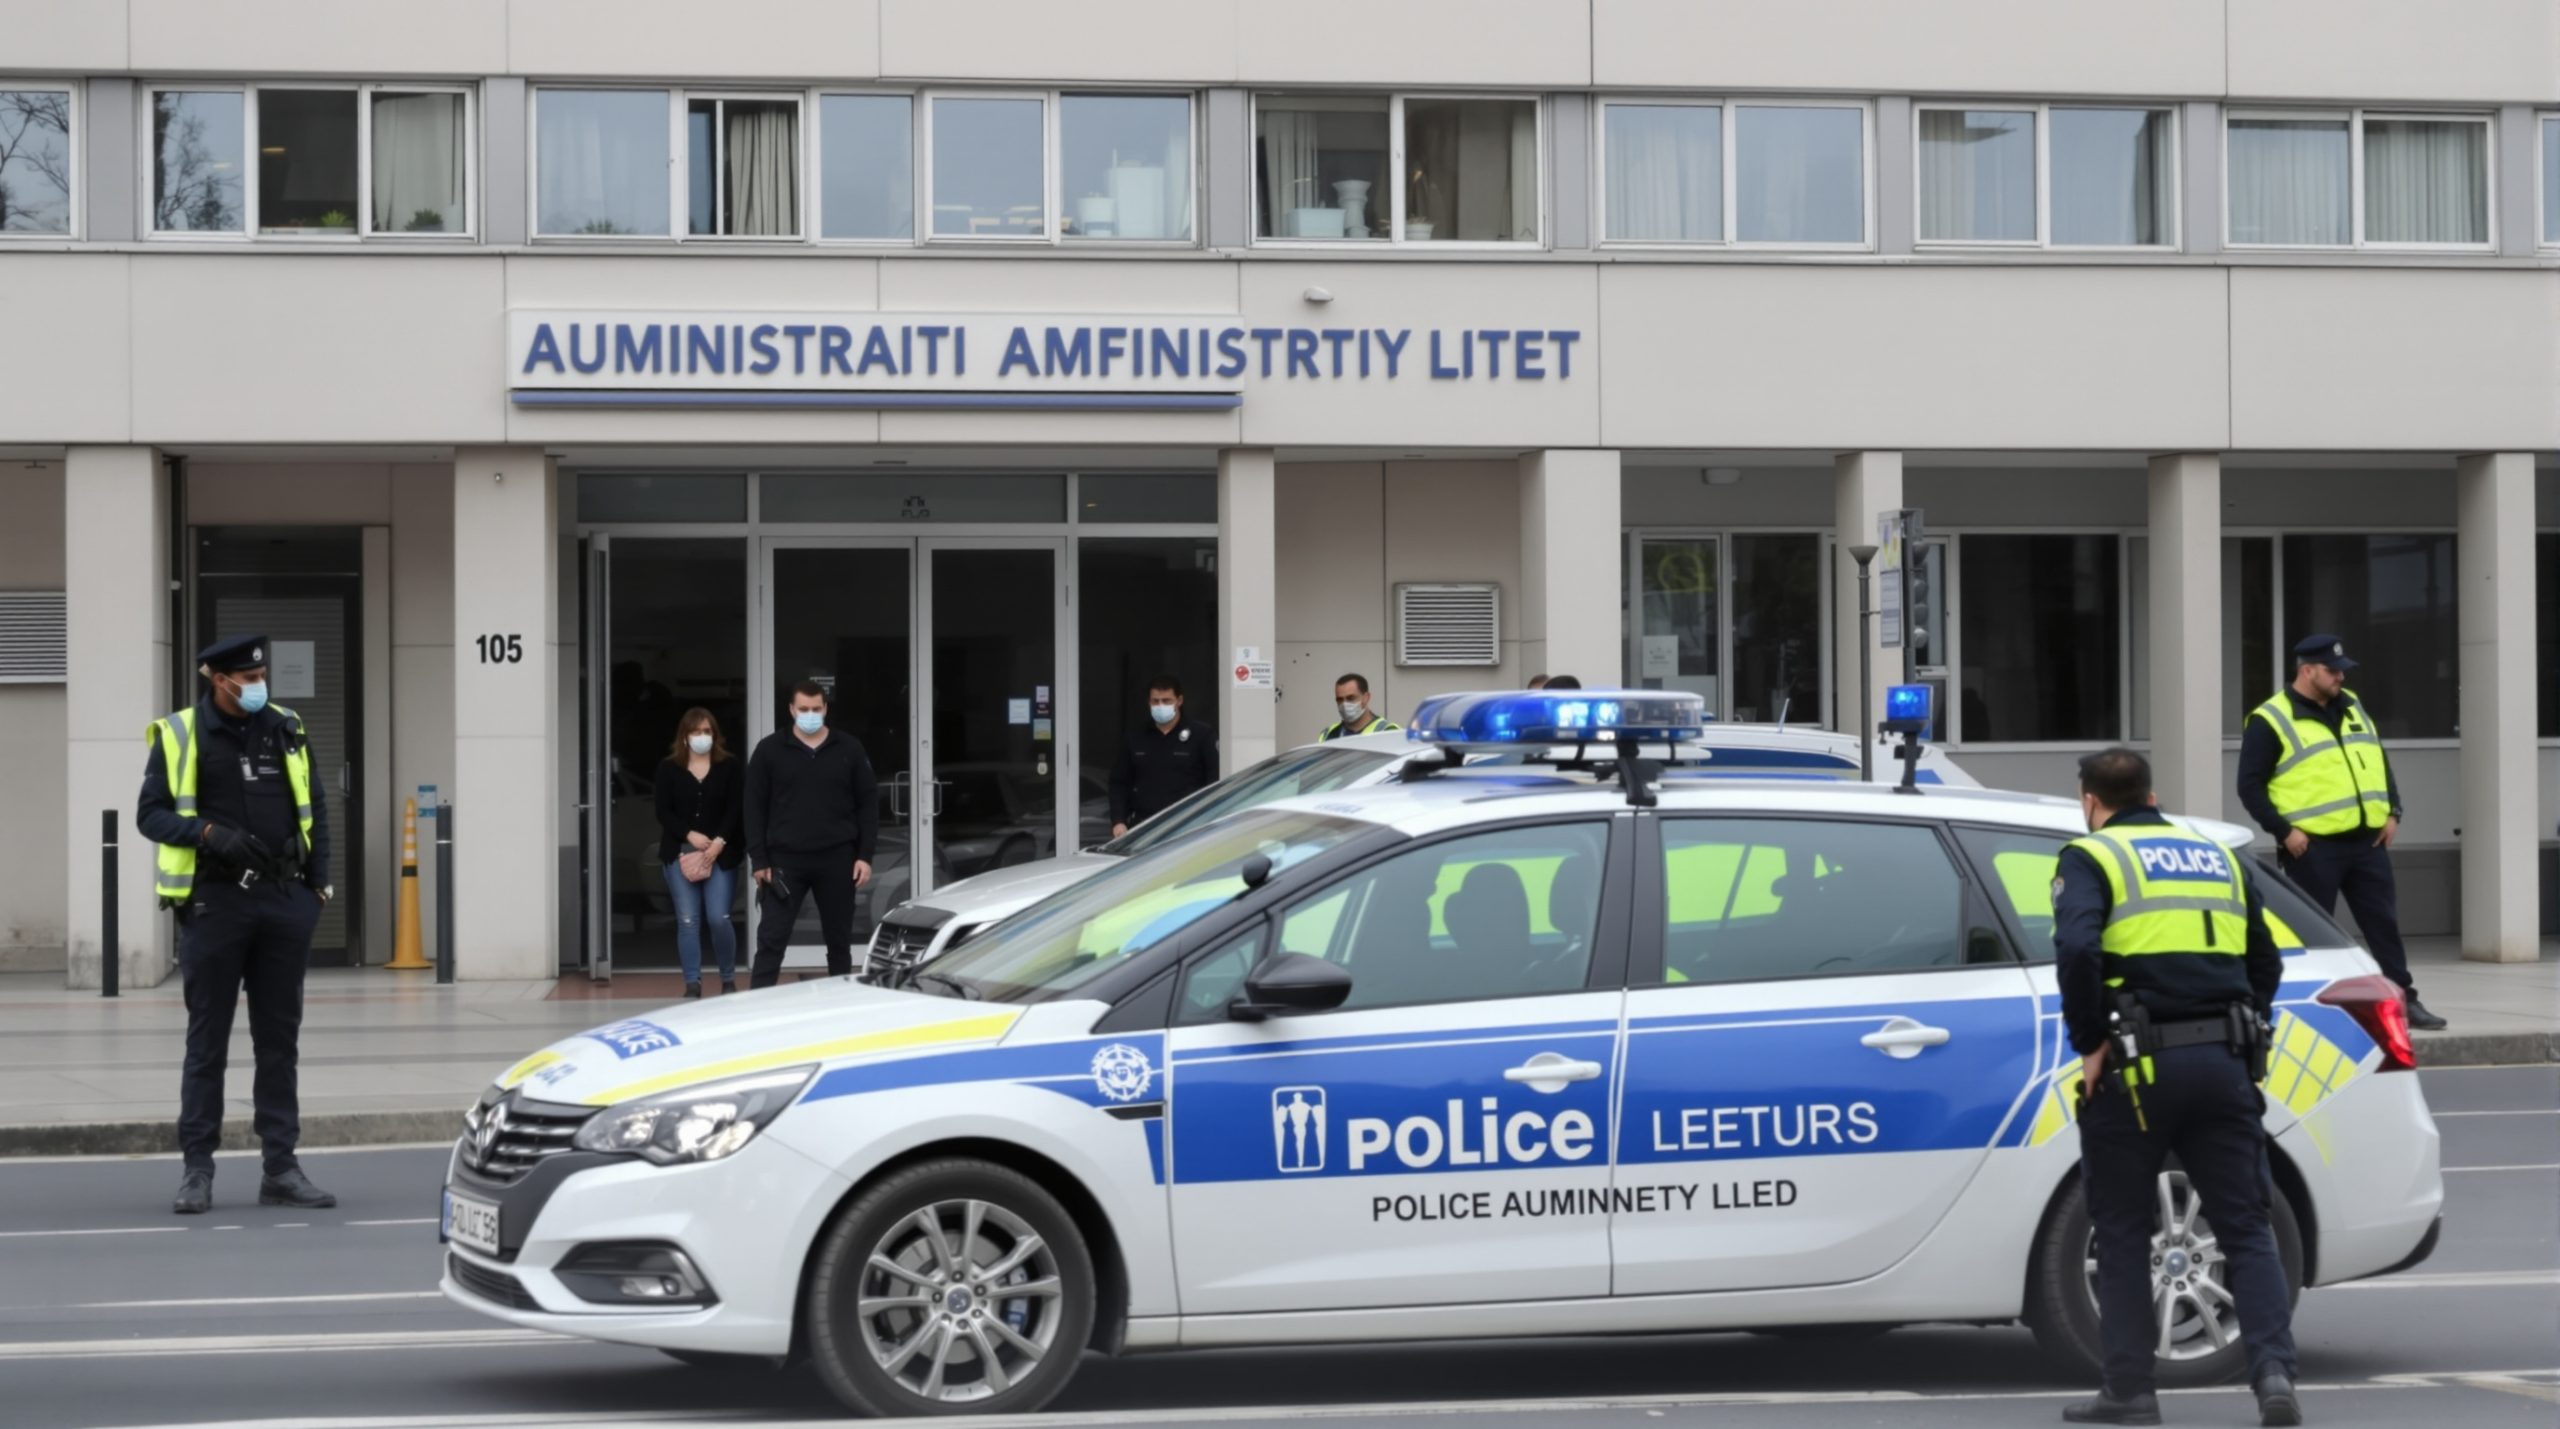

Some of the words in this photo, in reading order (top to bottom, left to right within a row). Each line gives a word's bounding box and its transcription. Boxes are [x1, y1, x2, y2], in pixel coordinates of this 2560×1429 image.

[522, 322, 966, 375] AUMINISTRAITI
[998, 326, 1411, 378] AMFINISTRTIY
[1430, 329, 1581, 379] LITET
[475, 633, 523, 664] 105
[2140, 847, 2227, 876] POLICE
[1652, 1101, 1879, 1152] LEETURS
[1372, 1192, 1492, 1222] POLICE
[1501, 1183, 1699, 1217] AUMINNETY
[1712, 1179, 1798, 1210] LLED
